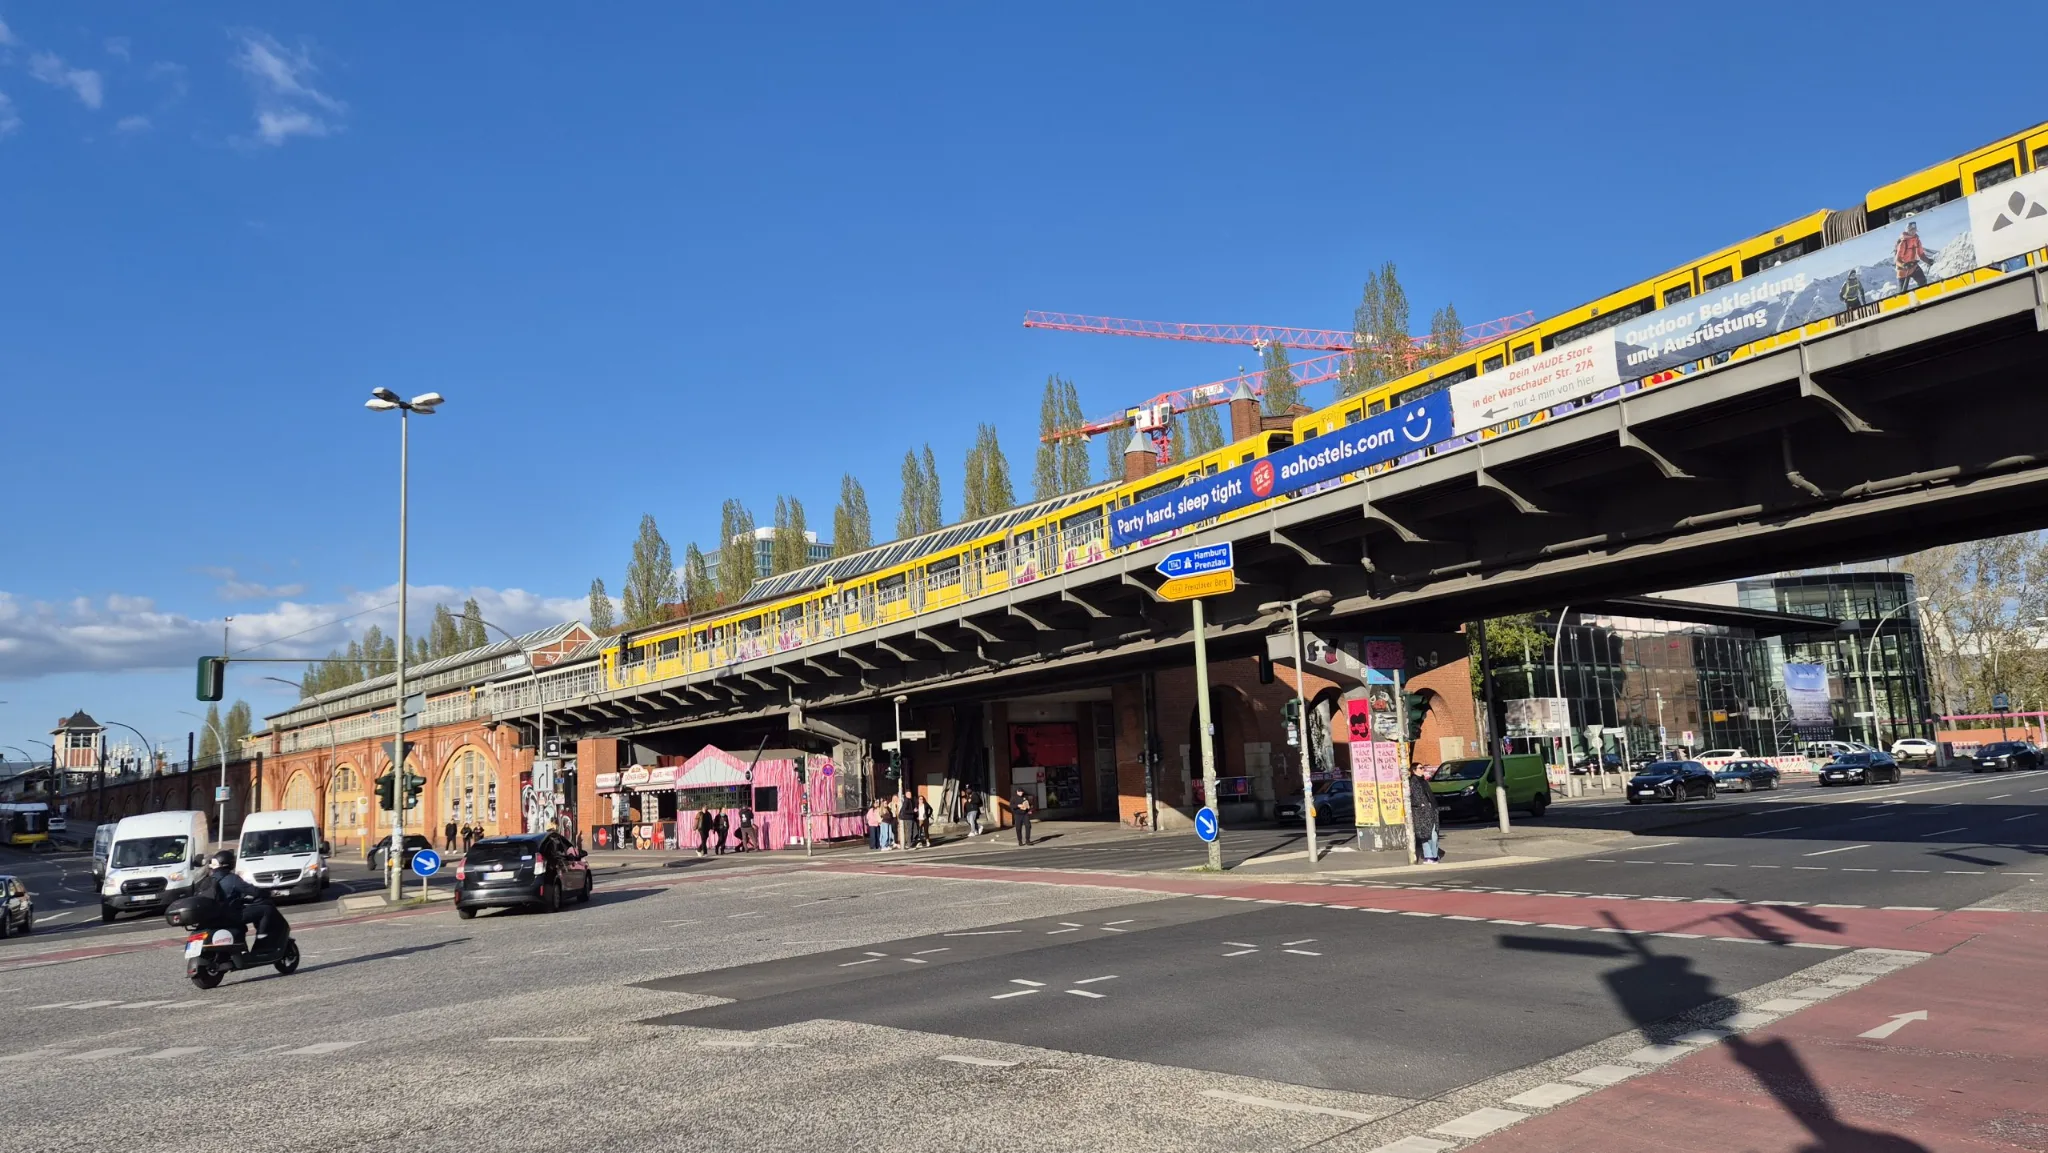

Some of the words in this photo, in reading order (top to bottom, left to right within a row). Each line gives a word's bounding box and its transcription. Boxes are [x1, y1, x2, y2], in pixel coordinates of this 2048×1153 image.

[1625, 309, 1695, 347] Outdoor
[1700, 272, 1807, 320] Bekleidung
[1626, 346, 1658, 366] und
[1663, 308, 1768, 355] Ausrüstung
[1509, 366, 1530, 381] Dein
[1532, 354, 1564, 374] VAUDE
[1566, 345, 1593, 361] Store
[1472, 397, 1480, 409] in
[1482, 392, 1497, 406] der
[1498, 374, 1552, 399] Warschauer
[1555, 366, 1572, 380] Str.
[1575, 360, 1594, 373] 27A
[1512, 397, 1527, 409] nur
[1529, 394, 1536, 402] 4
[1537, 389, 1556, 402] min
[1557, 382, 1575, 395] von
[1577, 374, 1596, 388] hier
[1281, 427, 1395, 479] aohostels.com
[1254, 473, 1264, 486] 12
[1263, 468, 1270, 480] €
[1117, 515, 1144, 535] Party
[1146, 502, 1176, 526] hard,
[1177, 494, 1209, 515] sleep
[1210, 479, 1242, 504] tight
[1194, 548, 1227, 560] Hamburg
[1194, 558, 1227, 570] Prenzlau
[1184, 581, 1212, 592] Prenzlauer
[1215, 578, 1227, 588] Berg
